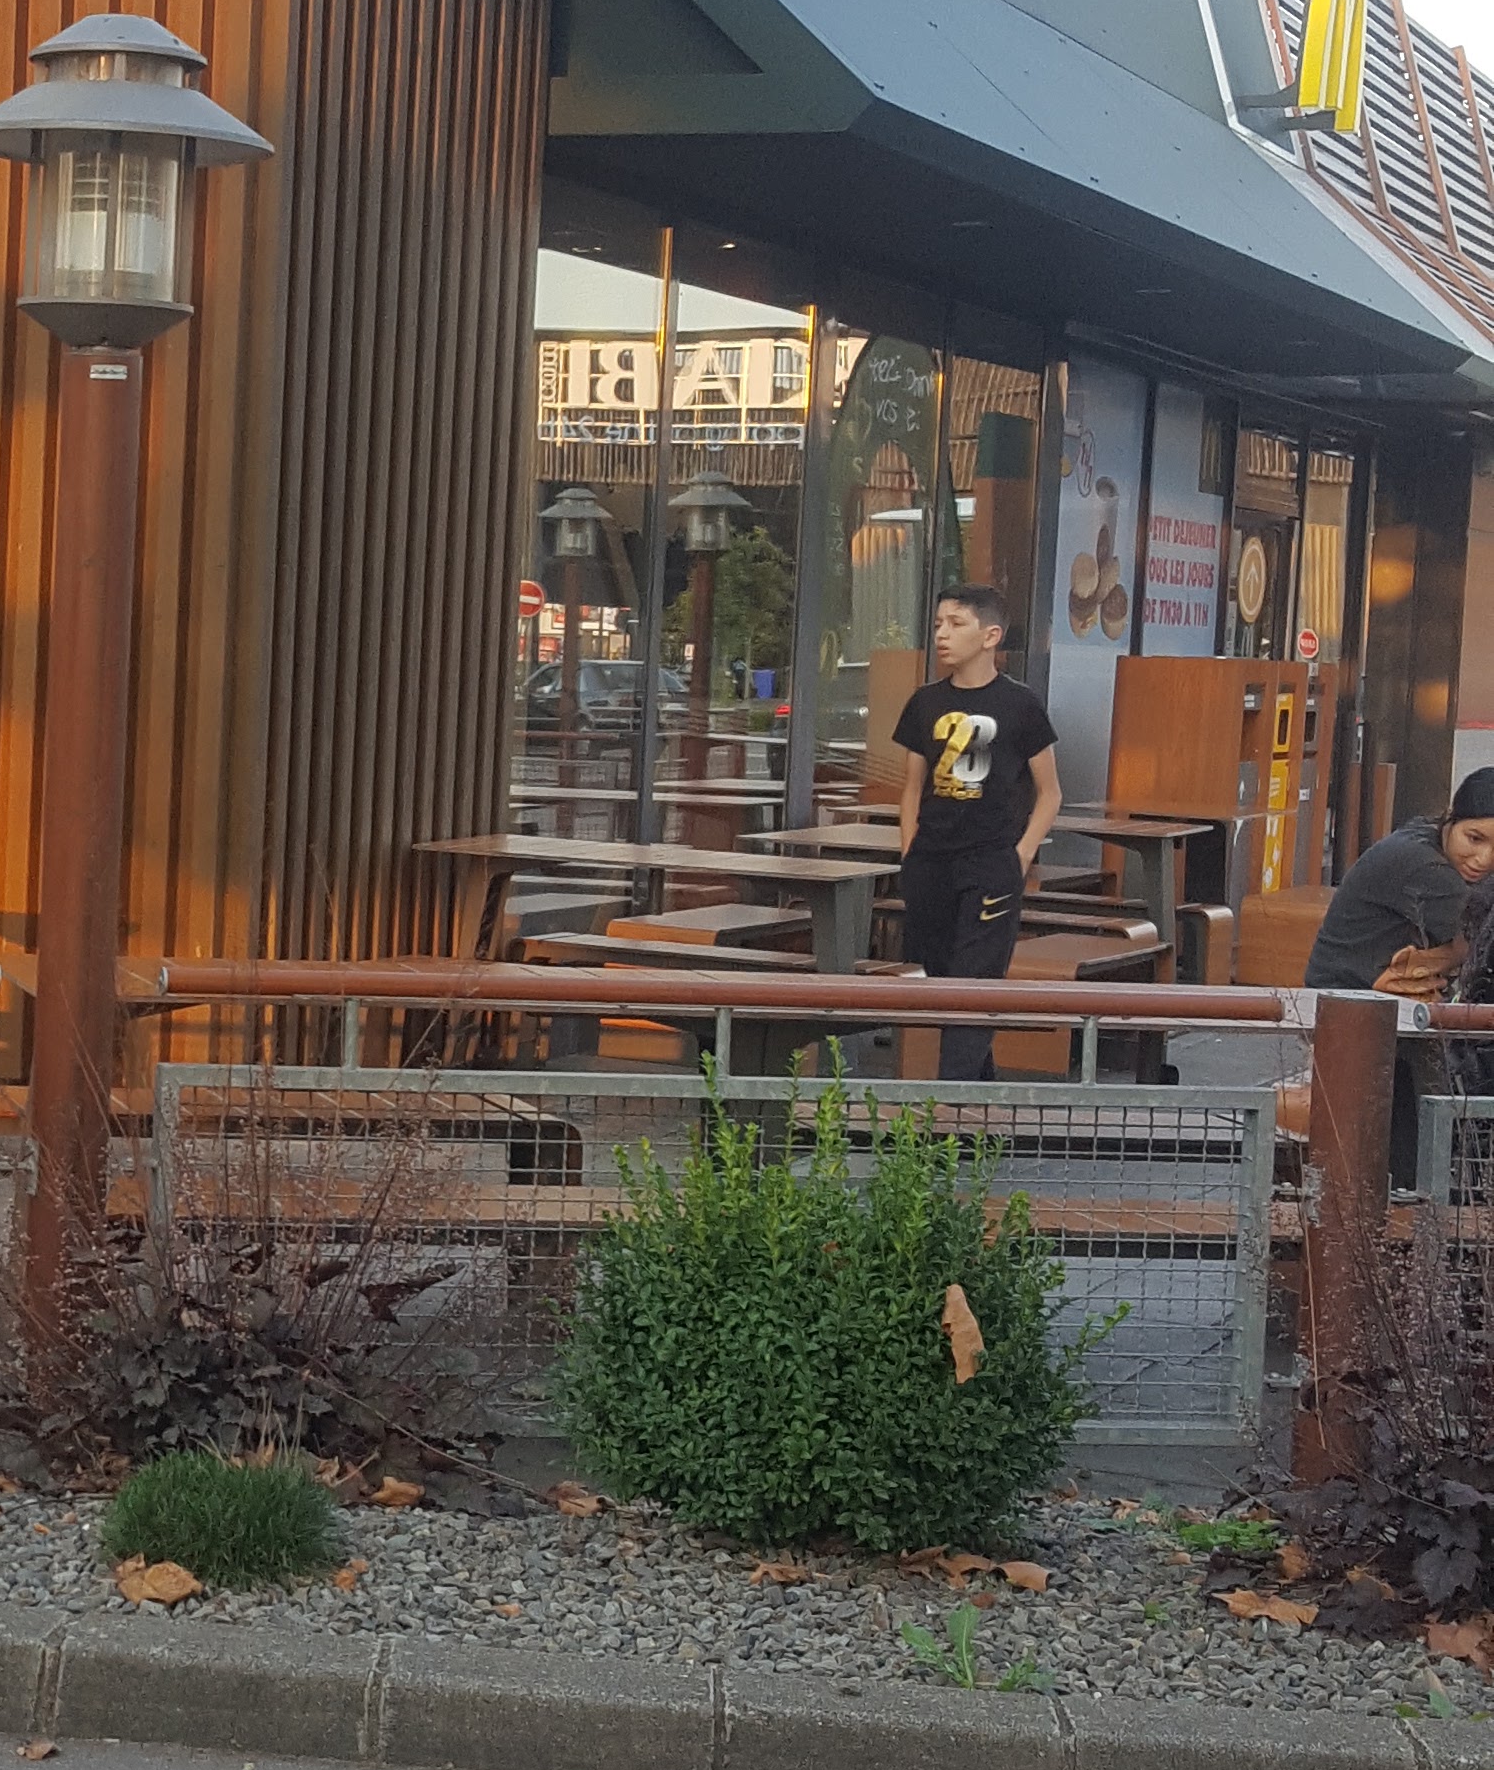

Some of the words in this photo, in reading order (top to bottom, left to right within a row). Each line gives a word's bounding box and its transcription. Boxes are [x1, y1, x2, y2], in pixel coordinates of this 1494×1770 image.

[1149, 557, 1168, 585] OUS
[1170, 560, 1185, 587] LES
[1186, 561, 1214, 590] JOURS
[1143, 597, 1157, 624] DE
[1193, 603, 1209, 628] 11H
